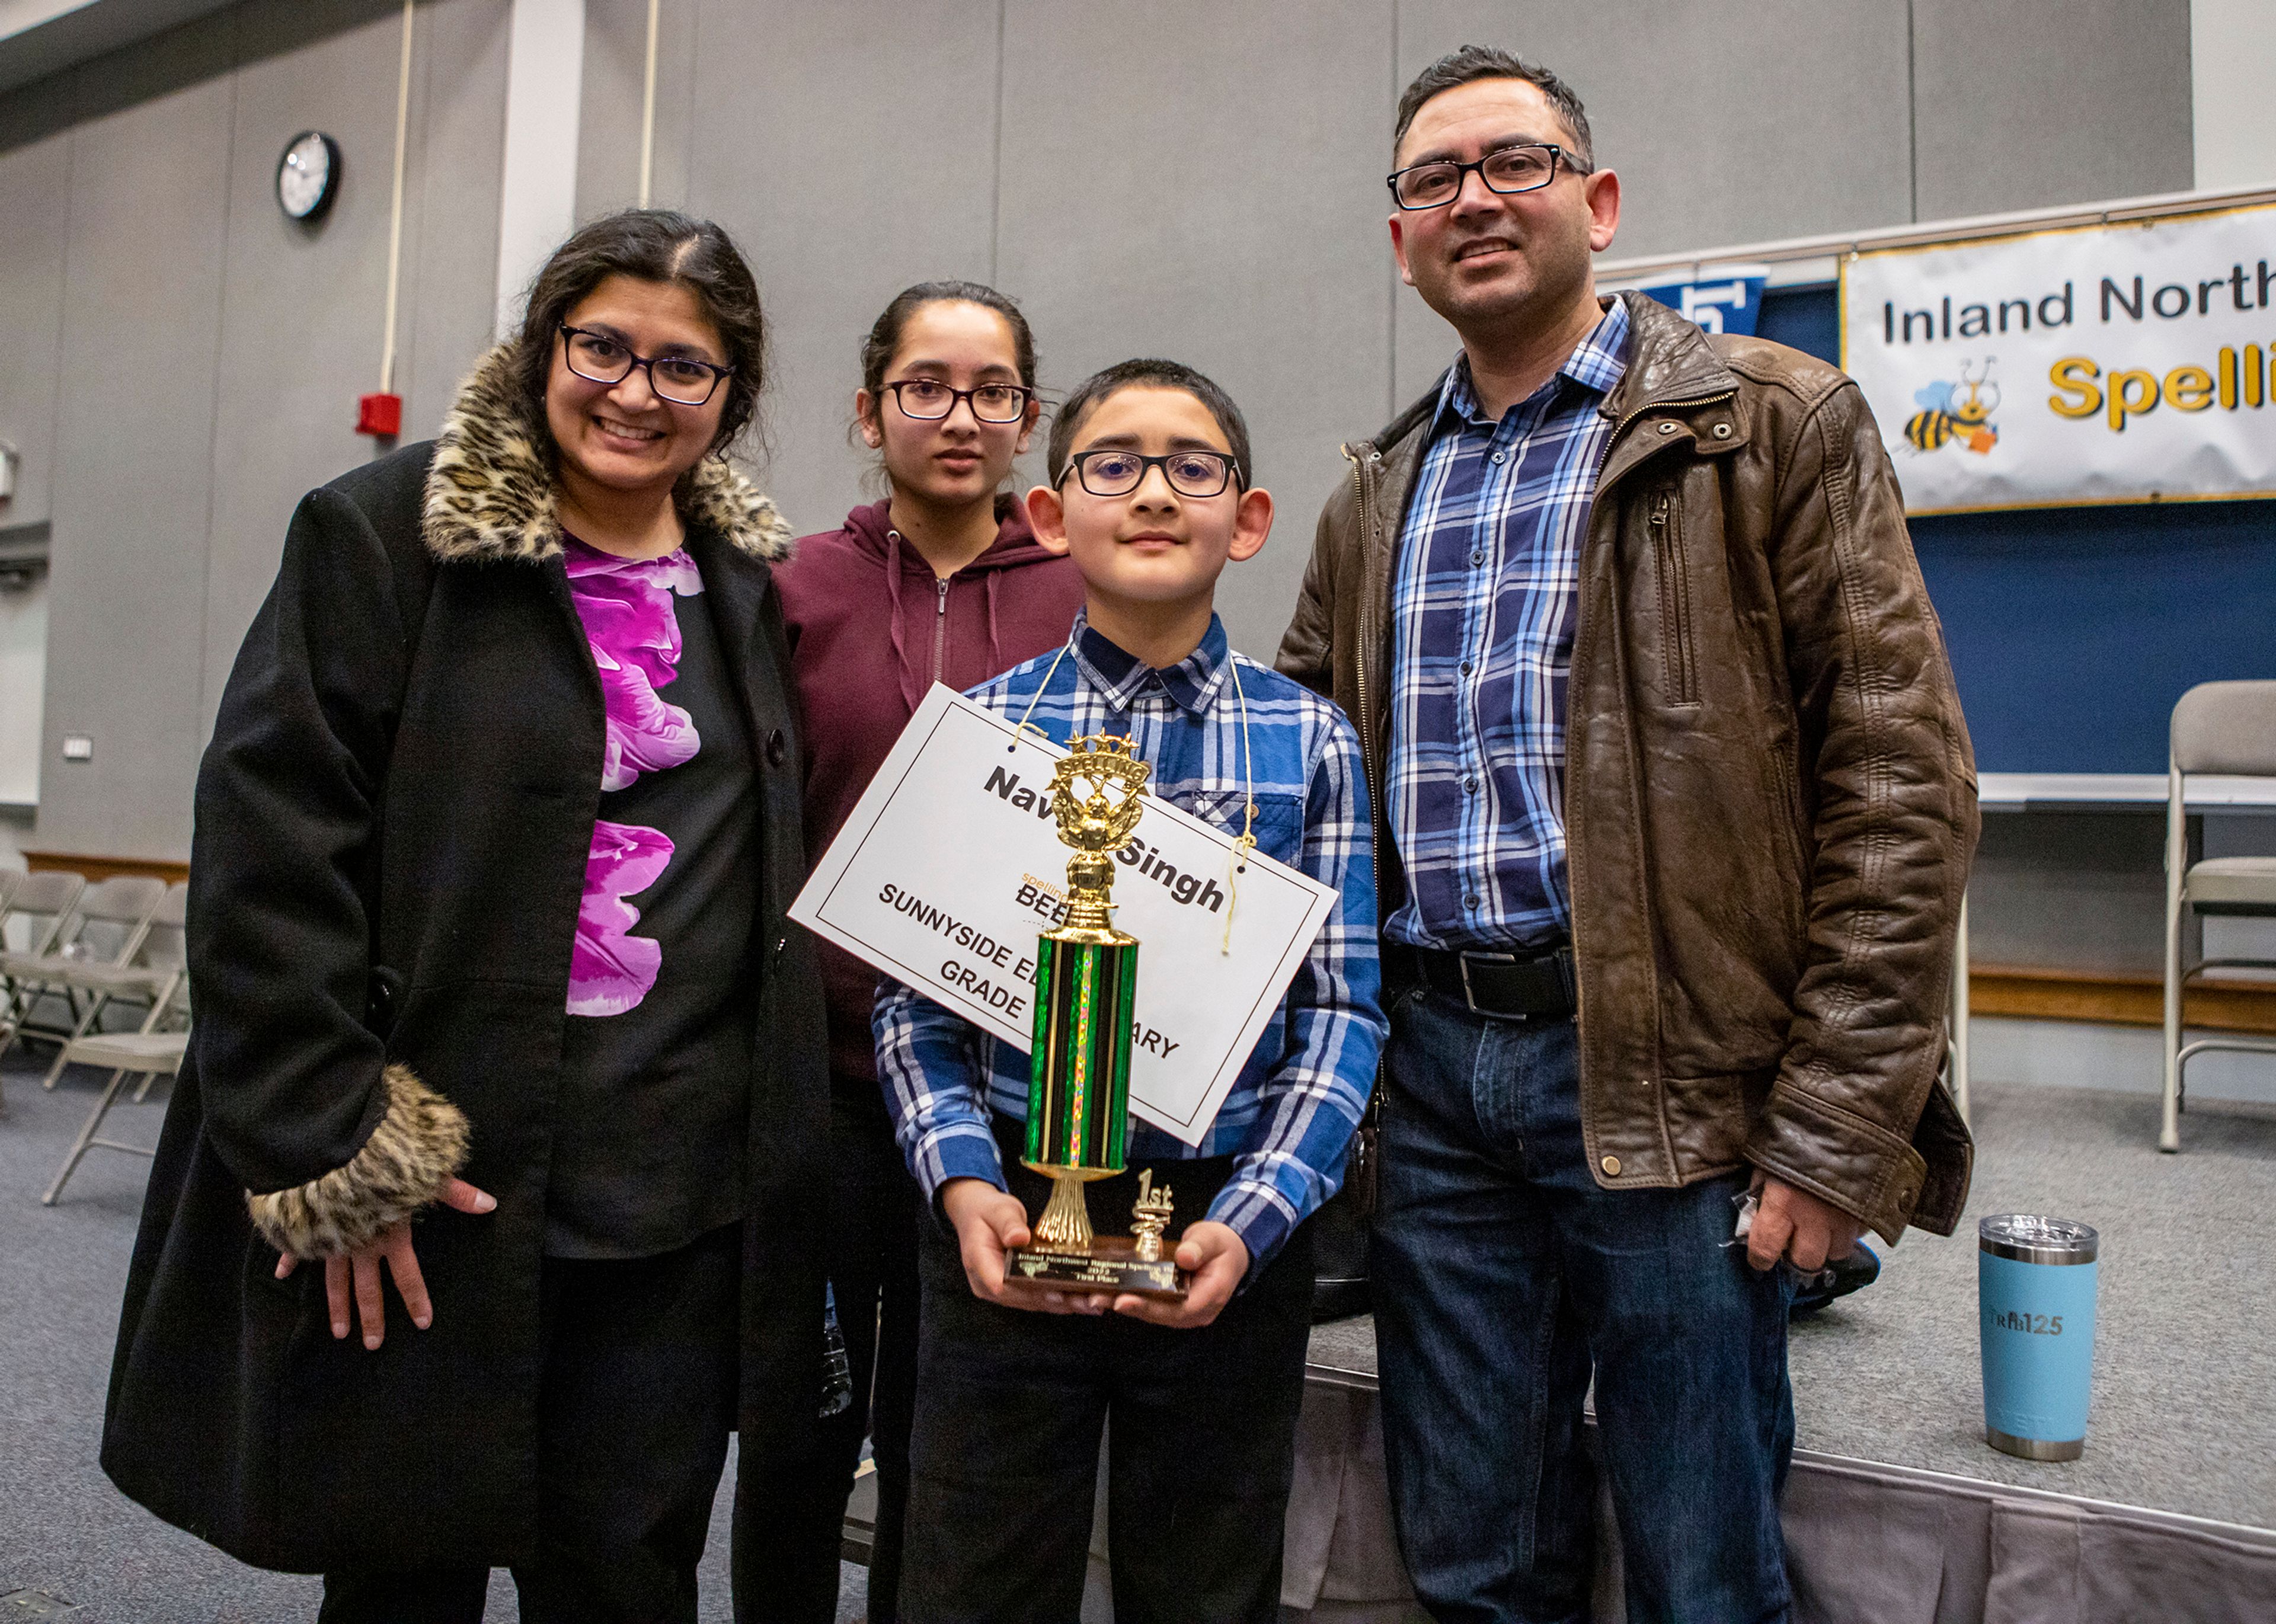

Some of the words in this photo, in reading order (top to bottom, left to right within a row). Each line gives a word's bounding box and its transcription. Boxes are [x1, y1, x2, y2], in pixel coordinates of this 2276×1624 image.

[1884, 280, 2073, 344] Inland
[1059, 756, 1144, 781] SPELLING
[1116, 835, 1225, 913] Singh
[878, 883, 1013, 968] SUNNYSIDE
[1015, 884, 1067, 925] BEE
[941, 960, 1027, 1019] GRADE
[1138, 1168, 1174, 1207] 1st
